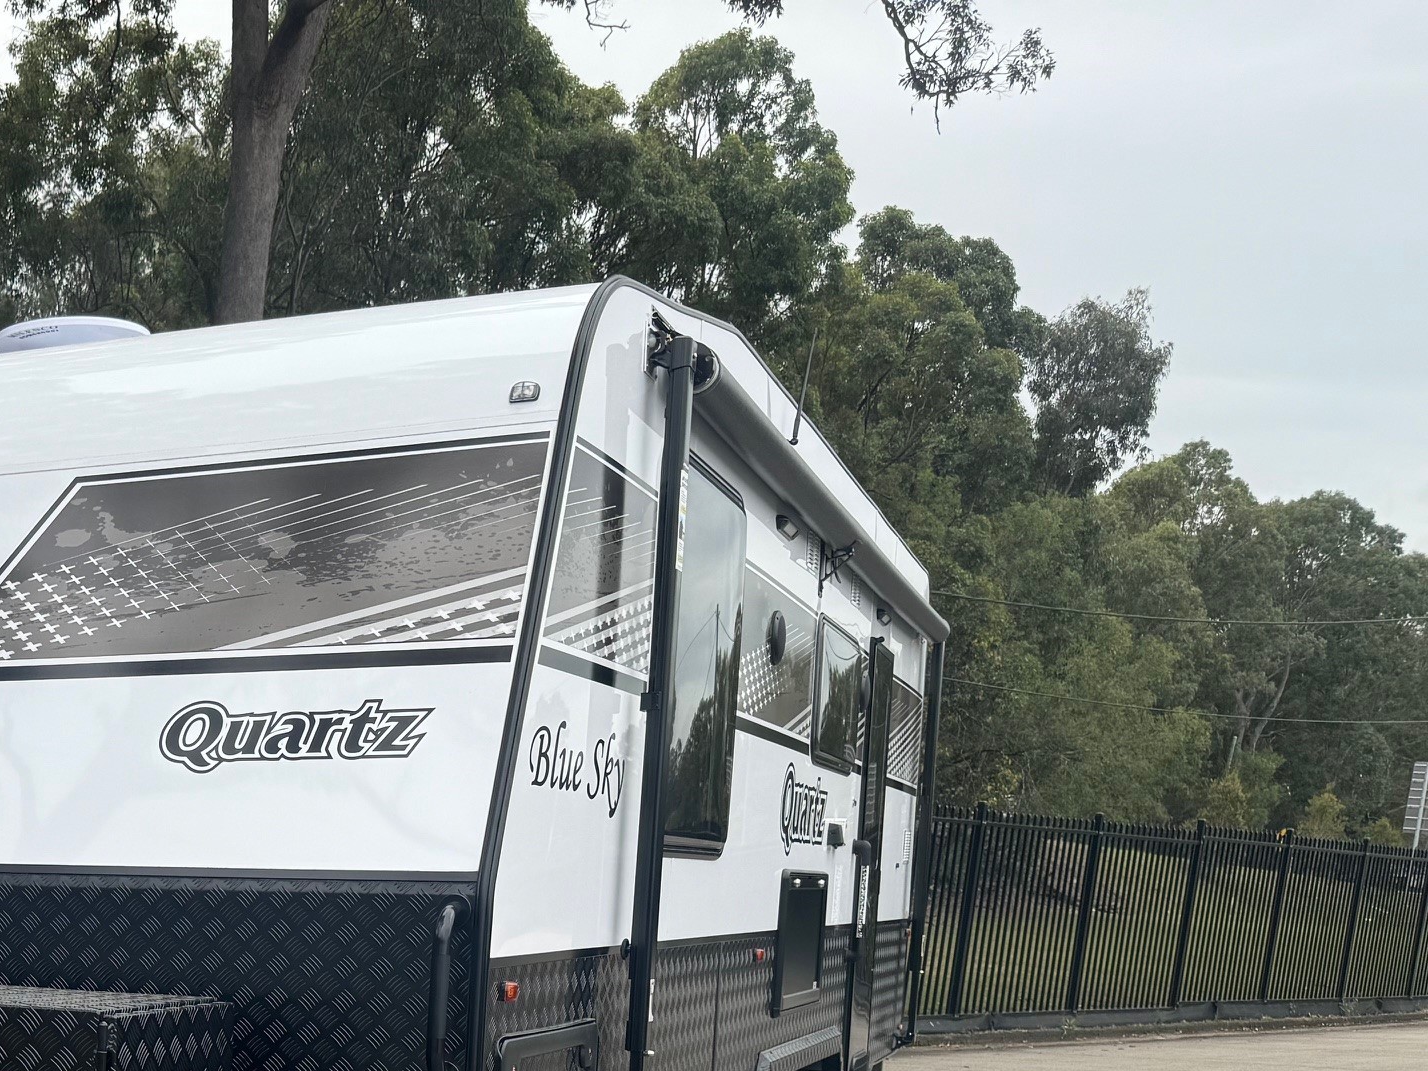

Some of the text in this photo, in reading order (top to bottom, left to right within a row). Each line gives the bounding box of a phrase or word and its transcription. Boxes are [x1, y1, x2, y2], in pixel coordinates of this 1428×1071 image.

[158, 698, 437, 775] Quartz
[529, 720, 626, 819] Blue Sky
[780, 761, 829, 857] Quartz
